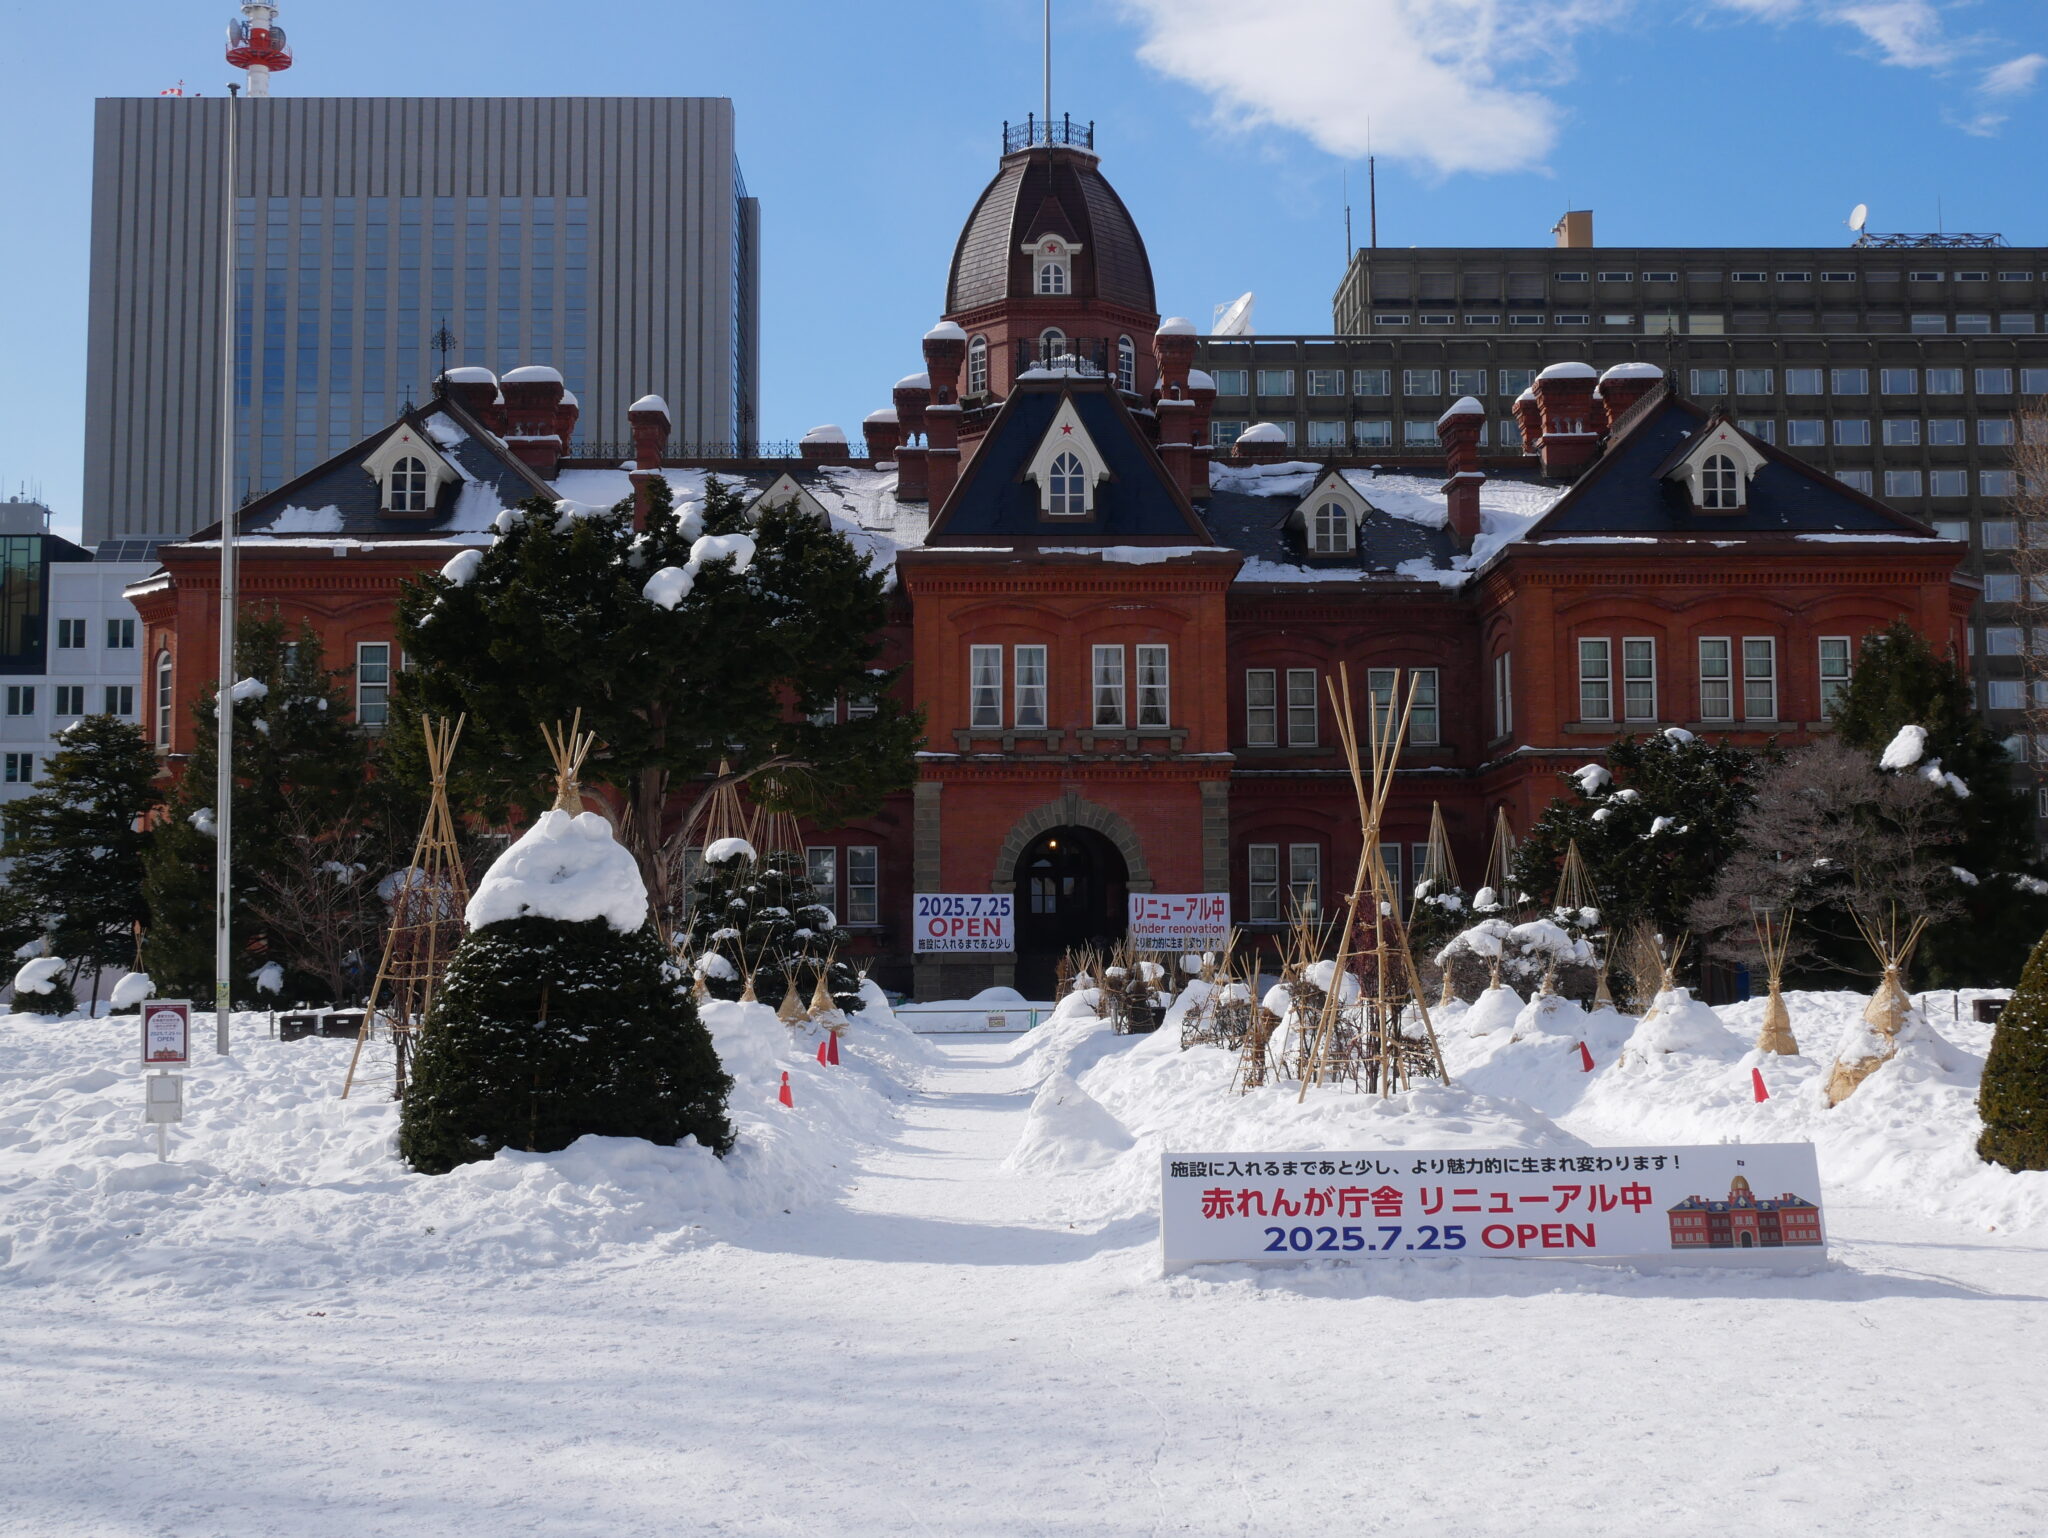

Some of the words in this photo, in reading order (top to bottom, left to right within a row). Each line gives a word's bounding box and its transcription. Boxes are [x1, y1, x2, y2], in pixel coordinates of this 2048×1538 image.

[919, 897, 1010, 916] 2025.7.25
[1135, 896, 1224, 921] リニューアル中
[928, 917, 1001, 937] OPEN
[1133, 923, 1165, 934] Under
[1169, 923, 1224, 934] renovation
[919, 939, 1010, 949] 施設に入れるまであと少し
[1202, 1186, 1403, 1219] 赤れんが庁舎
[1420, 1182, 1653, 1215] リニューアル中
[1264, 1225, 1467, 1252] 2025.7.25
[1482, 1223, 1597, 1249] OPEN
